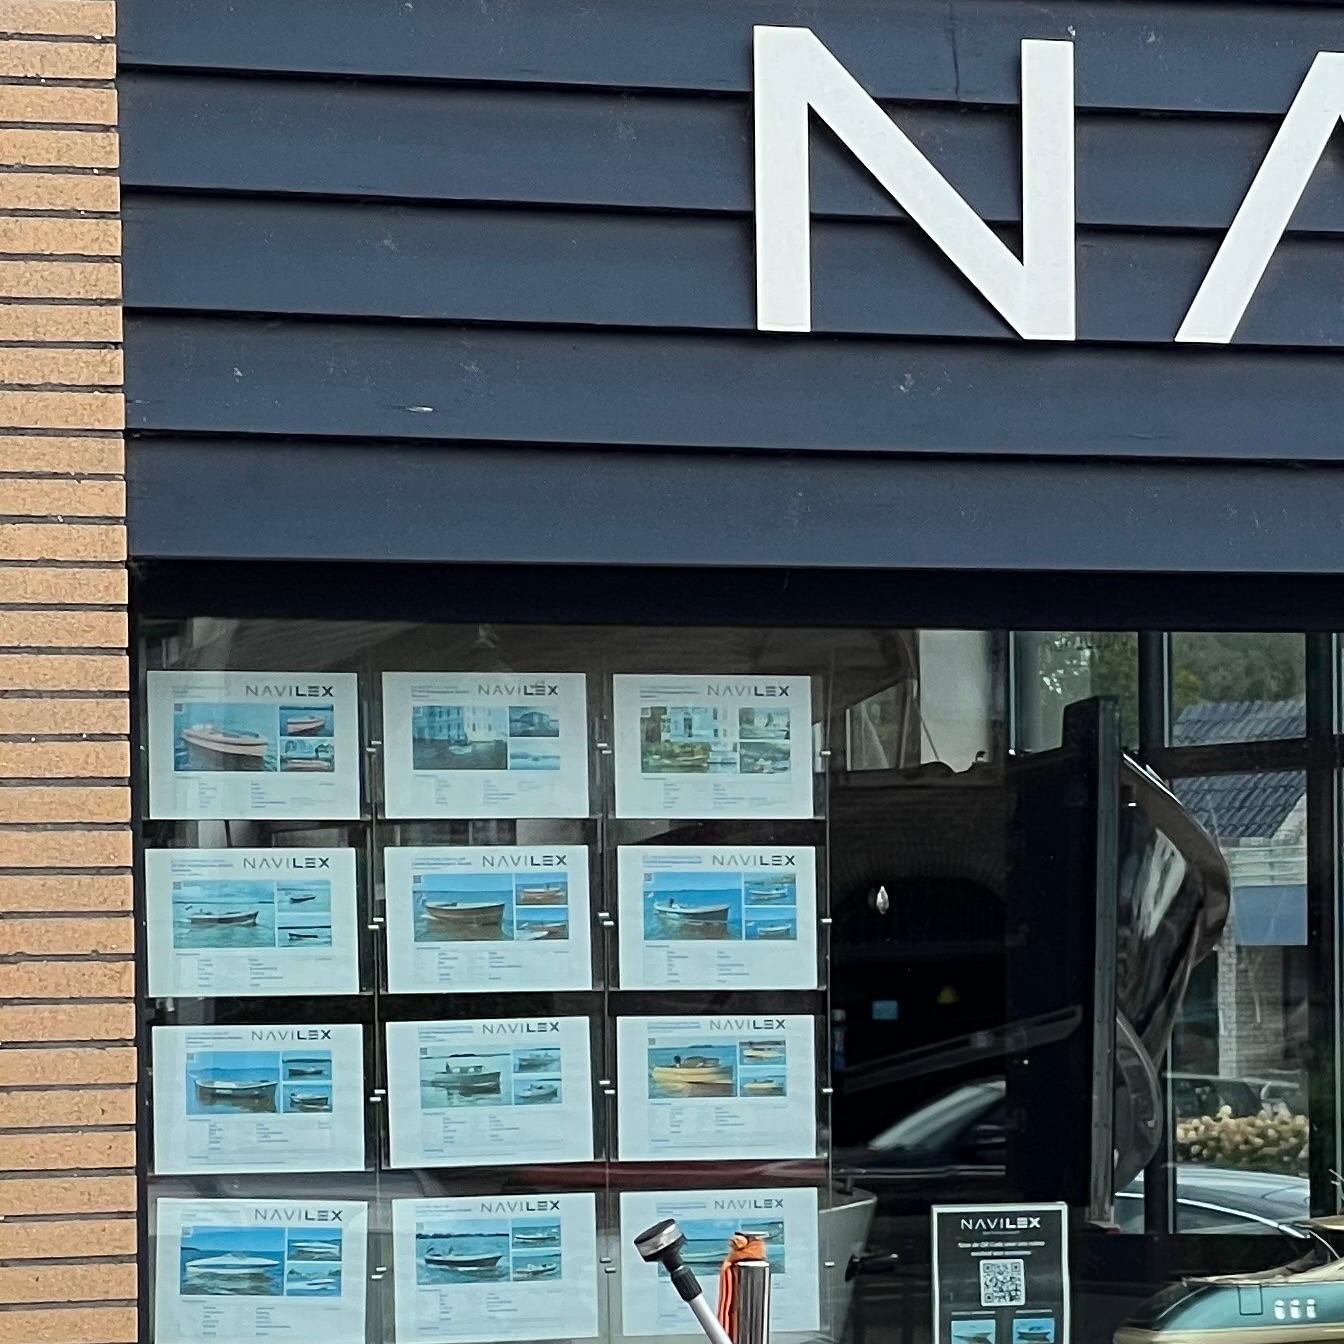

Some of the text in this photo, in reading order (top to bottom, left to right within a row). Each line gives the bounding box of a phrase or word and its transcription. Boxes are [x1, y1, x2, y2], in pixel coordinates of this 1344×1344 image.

[245, 684, 334, 698] NAVILEX
[478, 683, 559, 697] NAVILEX
[707, 684, 790, 697] NAVILEX
[242, 857, 330, 869] NAVILEX
[482, 854, 568, 867] NAVILEX
[712, 854, 796, 867] NAVILEX
[482, 1022, 560, 1034] NAVILEX
[709, 1019, 786, 1031] NAVILEX
[251, 1029, 331, 1041] NAVILEX
[480, 1200, 560, 1212] NAVILEX
[713, 1198, 784, 1209] NAVILEX
[254, 1208, 343, 1221] NAVILEX
[960, 1217, 1041, 1230] NAVILEX
